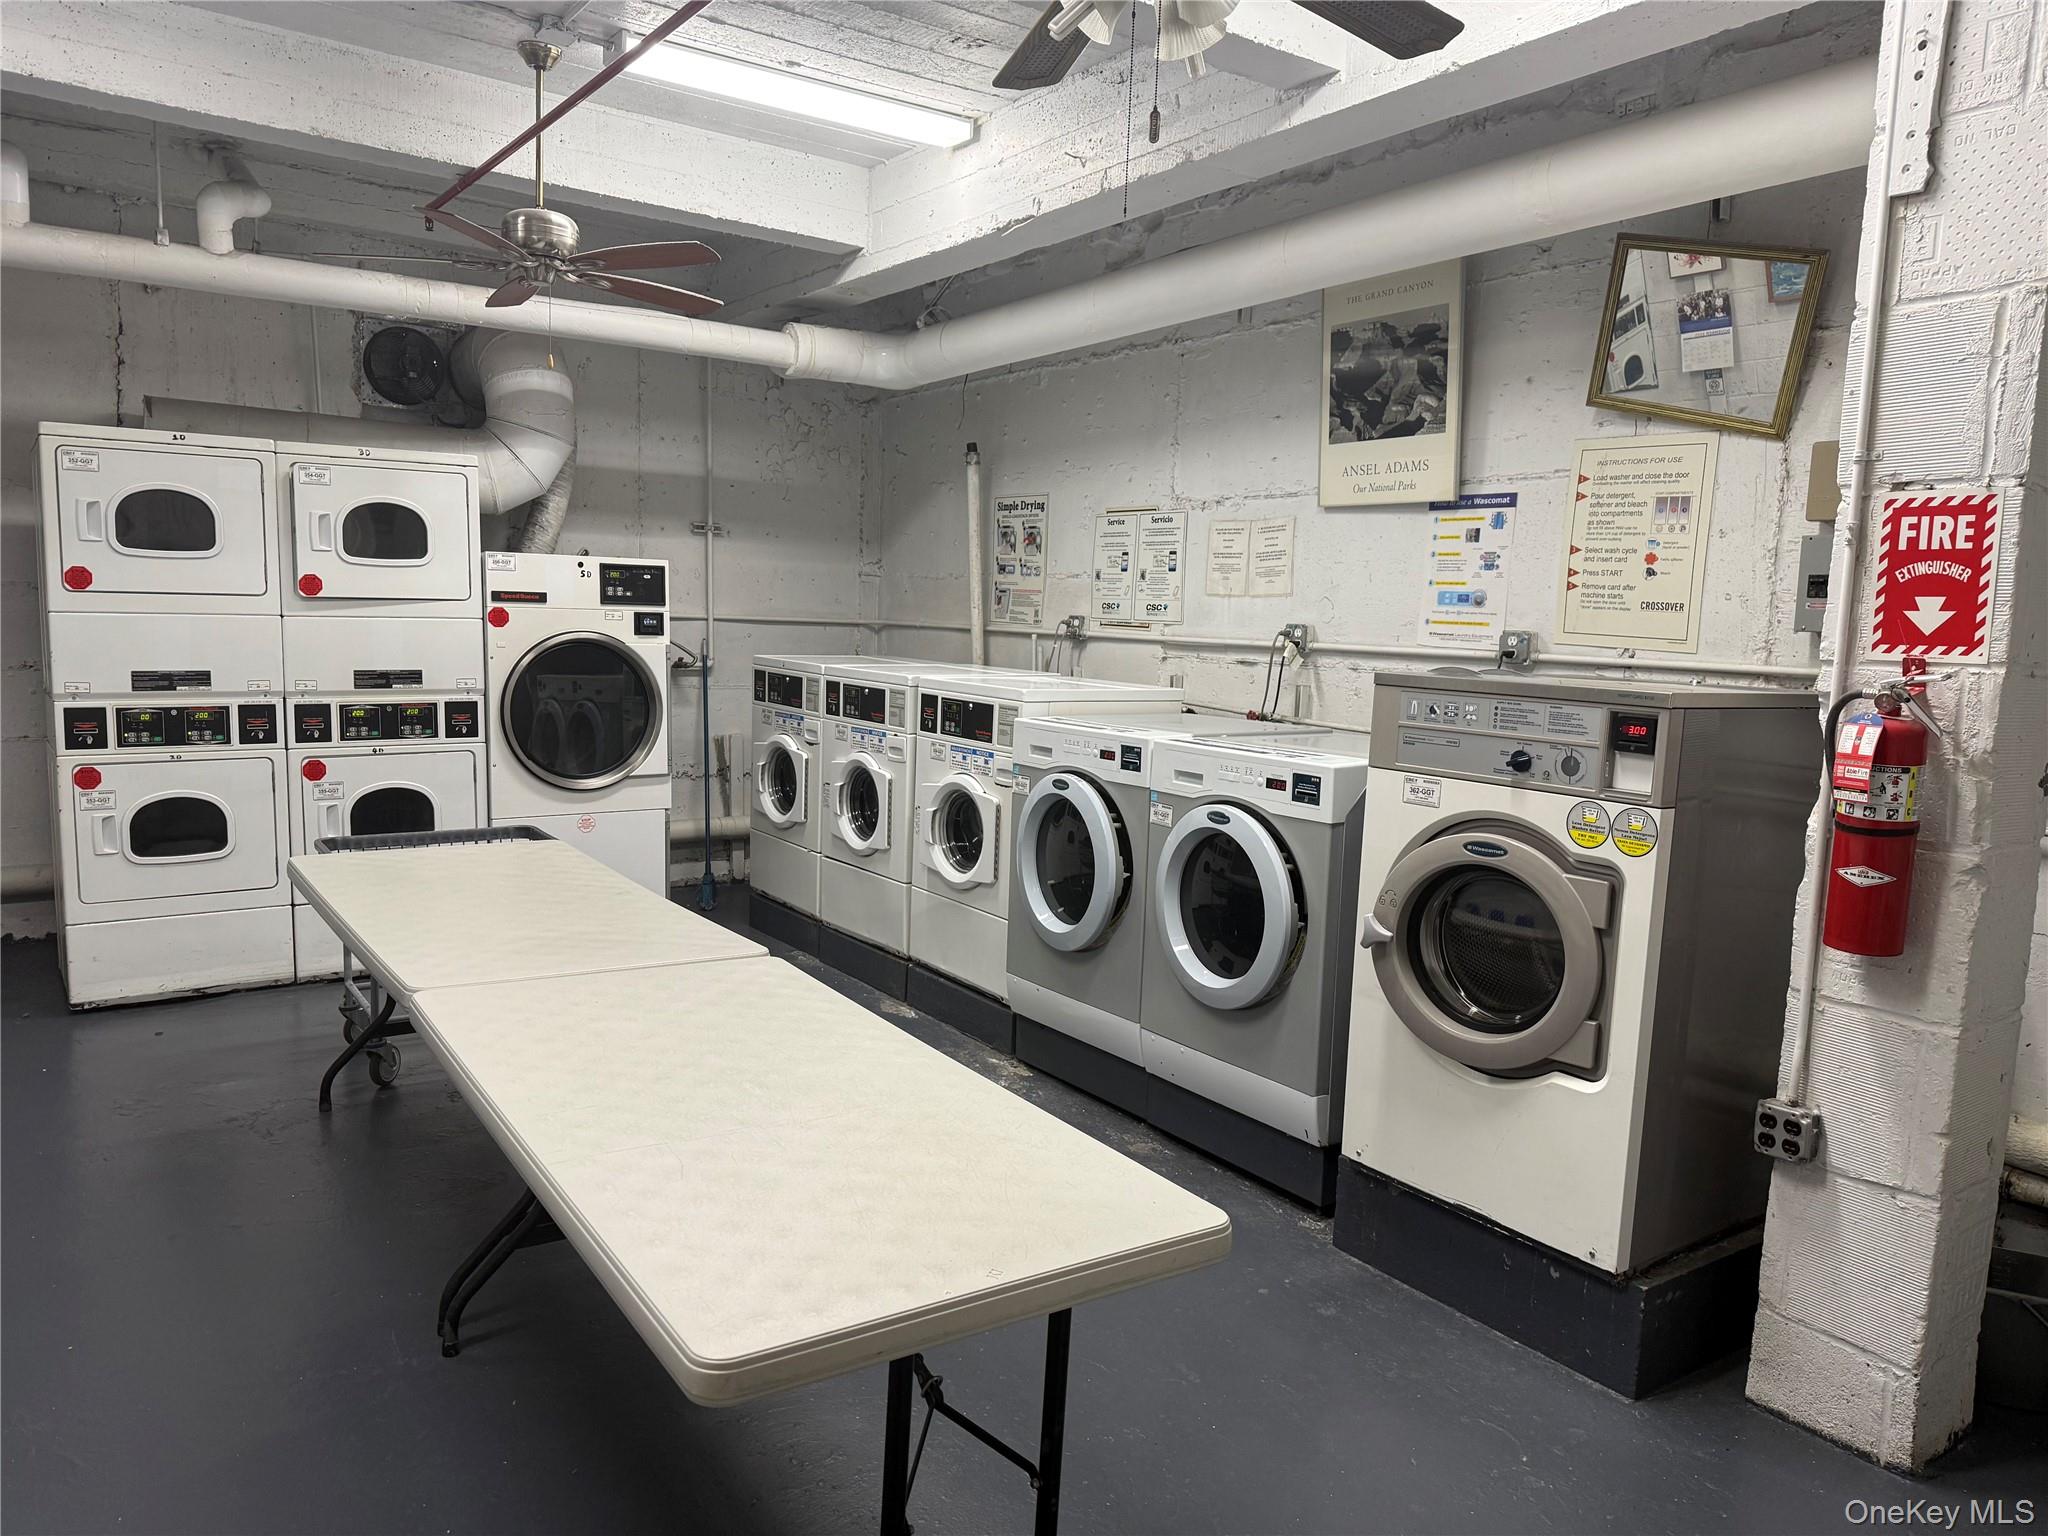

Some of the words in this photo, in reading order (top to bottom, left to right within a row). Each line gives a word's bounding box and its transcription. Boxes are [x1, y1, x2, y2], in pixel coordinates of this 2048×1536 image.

[1346, 295, 1362, 305] THE
[1365, 288, 1394, 301] GRAND
[1397, 280, 1434, 294] CANYON
[1597, 457, 1649, 467] INSTRUCTIONS
[1650, 457, 1666, 465] FOR
[1667, 456, 1684, 464] USE
[1342, 463, 1380, 477] ANSEL
[1384, 459, 1430, 474] ADAMS
[1352, 483, 1367, 494] Our
[1368, 480, 1396, 494] National
[1397, 480, 1417, 491] Parks
[1474, 496, 1510, 505] Wascomat
[997, 501, 1020, 513] Simple
[1020, 500, 1046, 512] Drying
[1600, 510, 1643, 518] compartments
[1107, 518, 1126, 526] Service
[1151, 516, 1174, 524] Servicio
[1898, 515, 1976, 551] FIRE
[1894, 560, 1972, 583] EXTINGUISHER
[1640, 600, 1684, 612] CROSSOVER
[1409, 786, 1435, 796] 362-GGT
[1472, 846, 1504, 854] Wascomat
